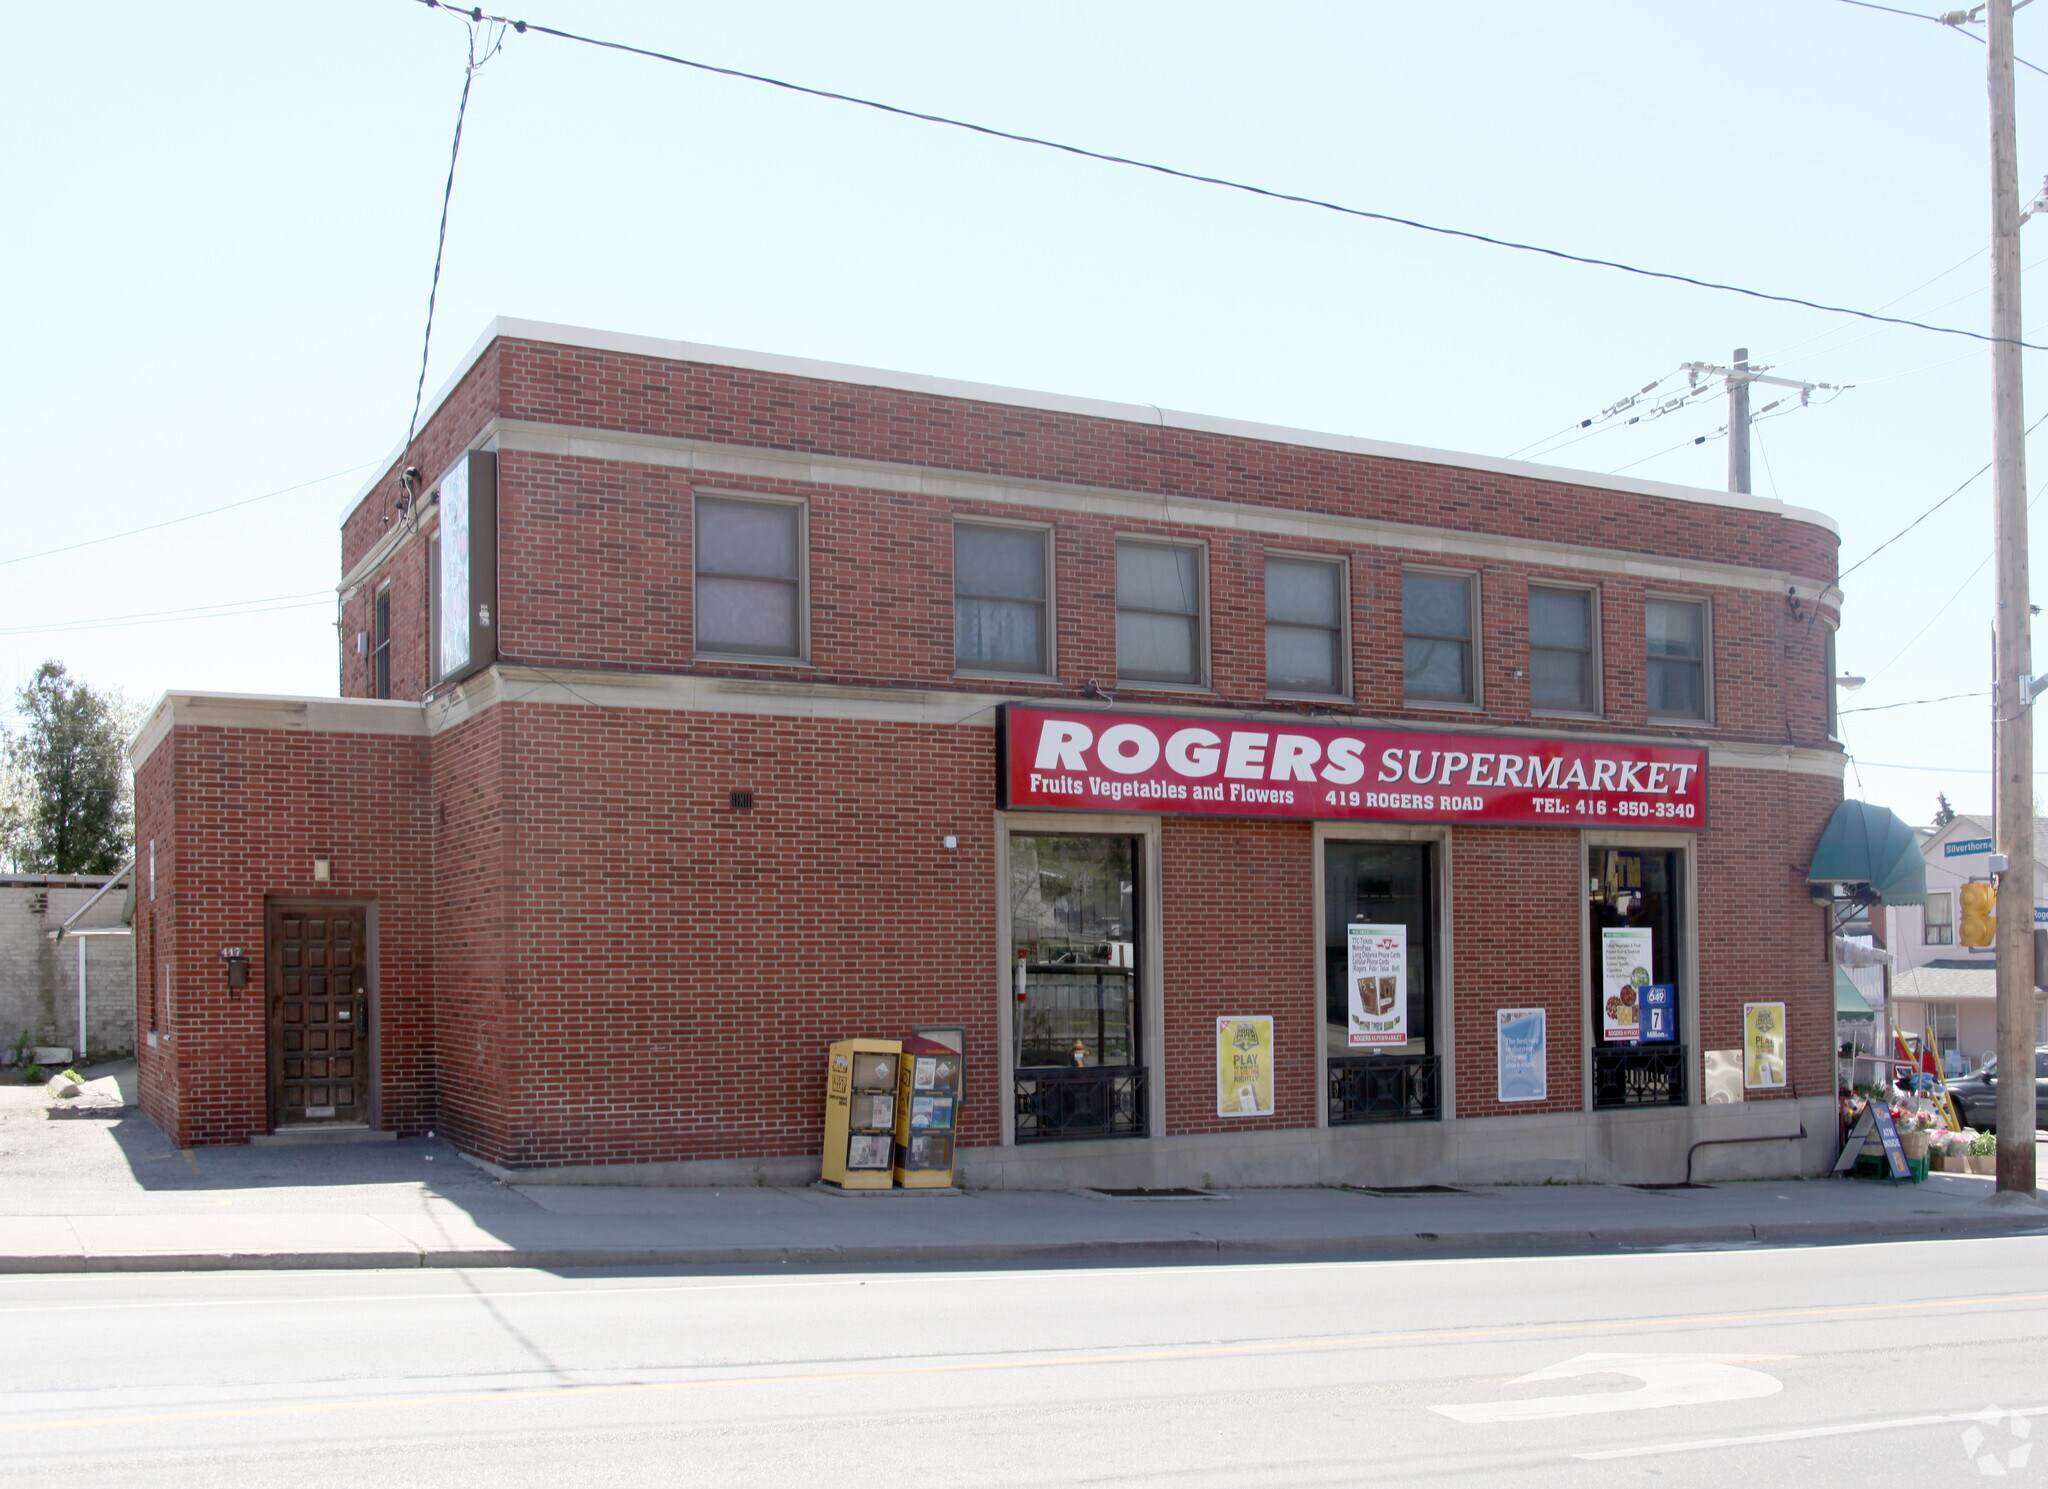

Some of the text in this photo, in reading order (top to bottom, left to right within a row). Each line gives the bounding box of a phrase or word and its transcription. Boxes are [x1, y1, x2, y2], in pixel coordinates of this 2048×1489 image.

[1034, 719, 1698, 796] ROGERS SUPERMARKET
[1030, 773, 1295, 805] Fruits Vegetables and Flowers
[1325, 790, 1484, 812] 419 ROGERS ROAD
[1532, 797, 1570, 815] TEL:
[1575, 800, 1607, 816] 416
[1945, 842, 1988, 854] Silverthorn
[1605, 851, 1641, 888] ATM
[1360, 937, 1373, 945] Tickets
[222, 947, 241, 957] 417
[1654, 1012, 1659, 1028] 7
[1233, 1054, 1258, 1066] PLAY
[1234, 1075, 1258, 1083] NIGHTLY
[1883, 1128, 1895, 1137] ATM
[1883, 1138, 1900, 1148] INSIDE
